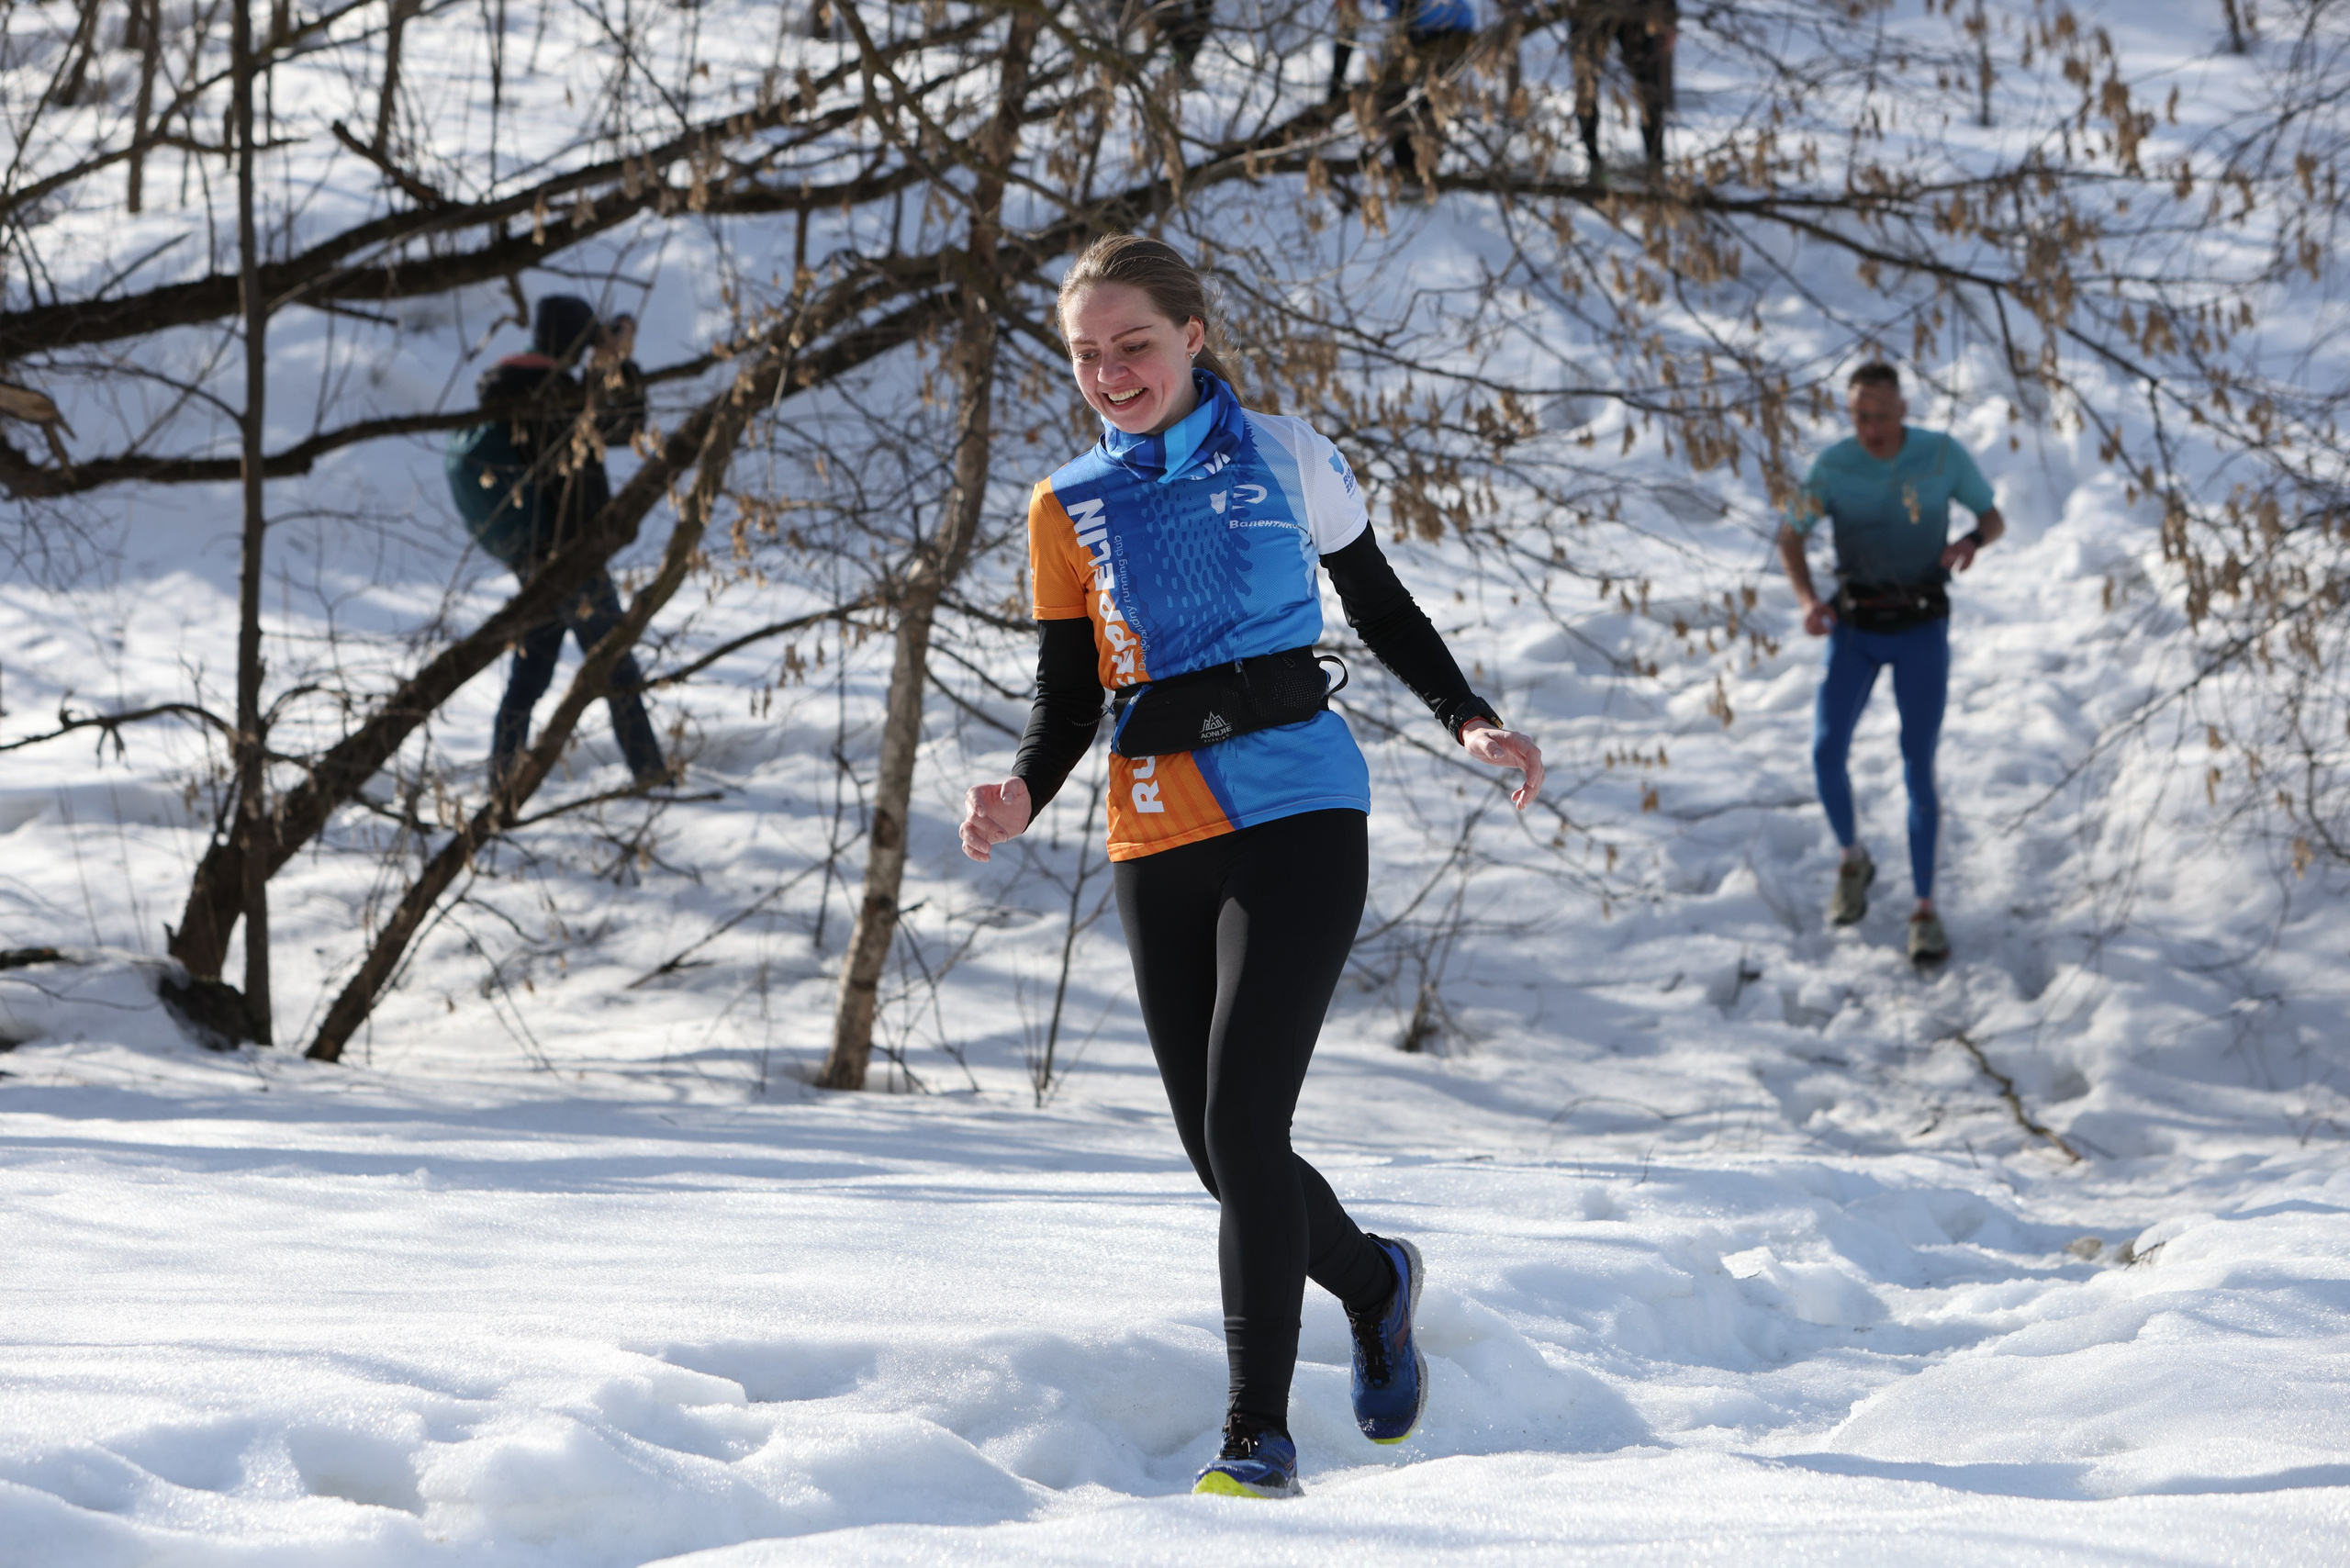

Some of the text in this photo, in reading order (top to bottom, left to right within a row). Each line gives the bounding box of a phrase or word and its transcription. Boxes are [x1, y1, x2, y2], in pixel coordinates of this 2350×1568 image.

[1113, 534, 1150, 671] Dolgoprudny running club
[1201, 724, 1232, 739] AONIJIE
[1131, 756, 1165, 813] RU
